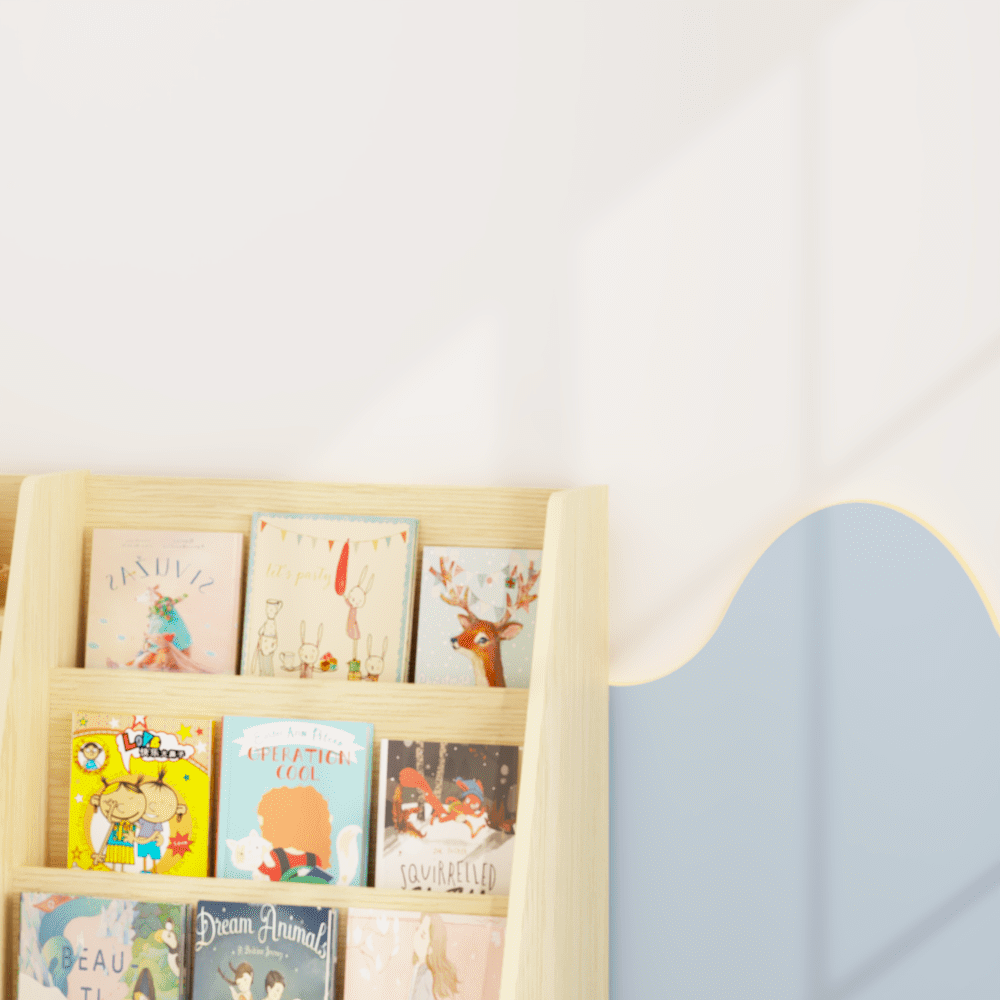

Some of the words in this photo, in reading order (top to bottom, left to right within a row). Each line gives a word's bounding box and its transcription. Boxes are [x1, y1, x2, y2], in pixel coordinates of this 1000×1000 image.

[247, 746, 350, 766] OPERATION
[275, 764, 321, 781] COOL
[400, 860, 497, 891] SQUIRRELLED
[195, 906, 256, 952] Dream
[258, 903, 328, 959] Animals
[61, 946, 139, 973] BEAU-
